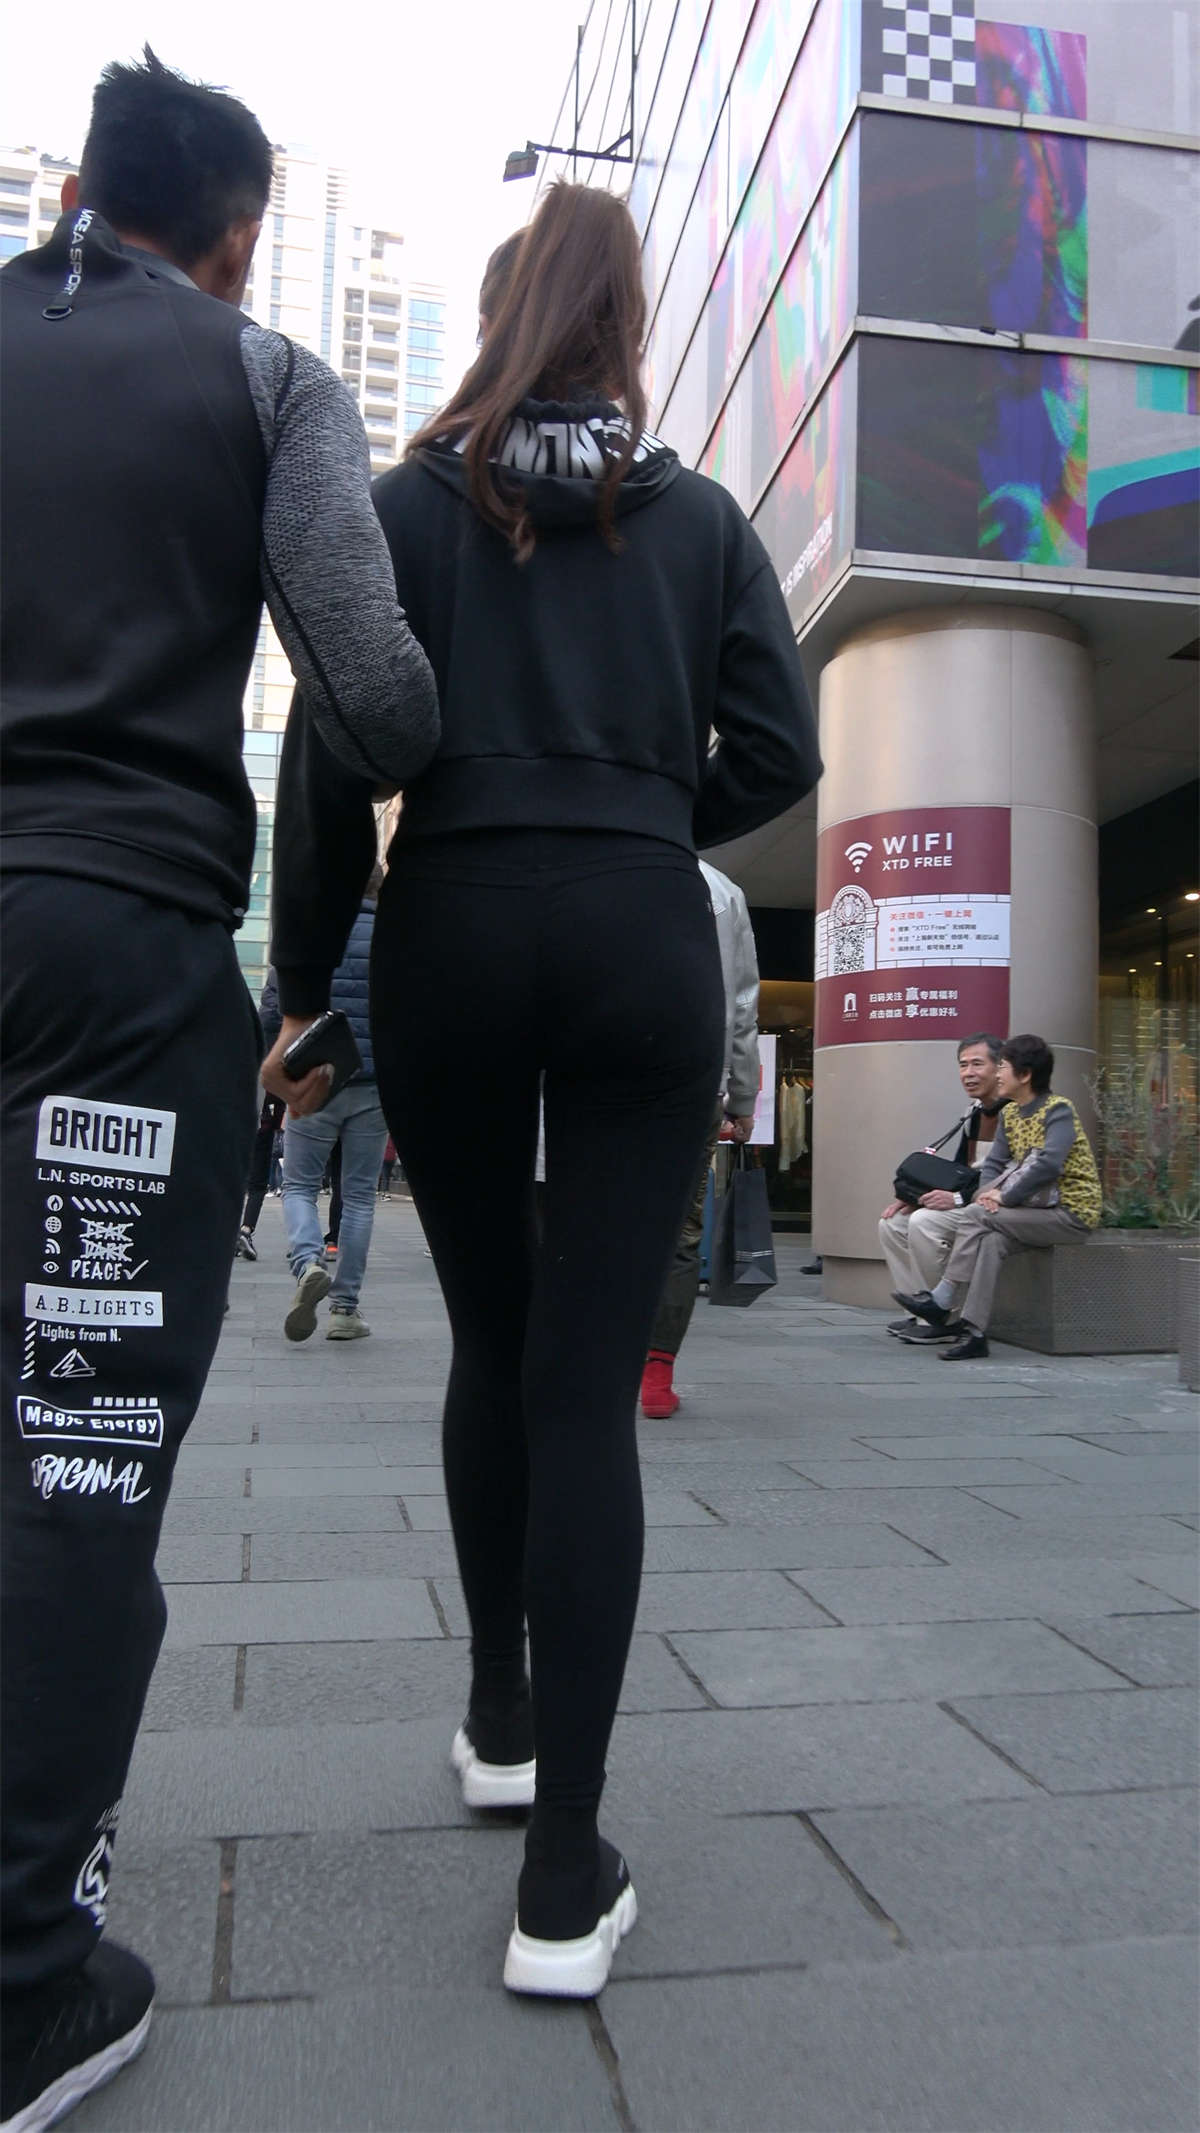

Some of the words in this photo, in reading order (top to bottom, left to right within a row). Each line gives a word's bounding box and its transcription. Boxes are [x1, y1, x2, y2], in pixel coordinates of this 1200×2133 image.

[882, 833, 952, 855] WIFI
[882, 858, 910, 871] XTD
[914, 856, 952, 868] FREE
[50, 1106, 163, 1159] BRIGHT
[38, 1167, 66, 1183] L.N.
[69, 1171, 135, 1191] SPORTS
[138, 1180, 166, 1194] LAB
[70, 1259, 123, 1281] PEACE
[35, 1294, 155, 1316] A.B.LIGHTS
[40, 1323, 76, 1342] Lights
[78, 1327, 107, 1342] from
[110, 1329, 122, 1342] N.
[26, 1405, 84, 1427] Magic
[90, 1417, 158, 1434] Energy
